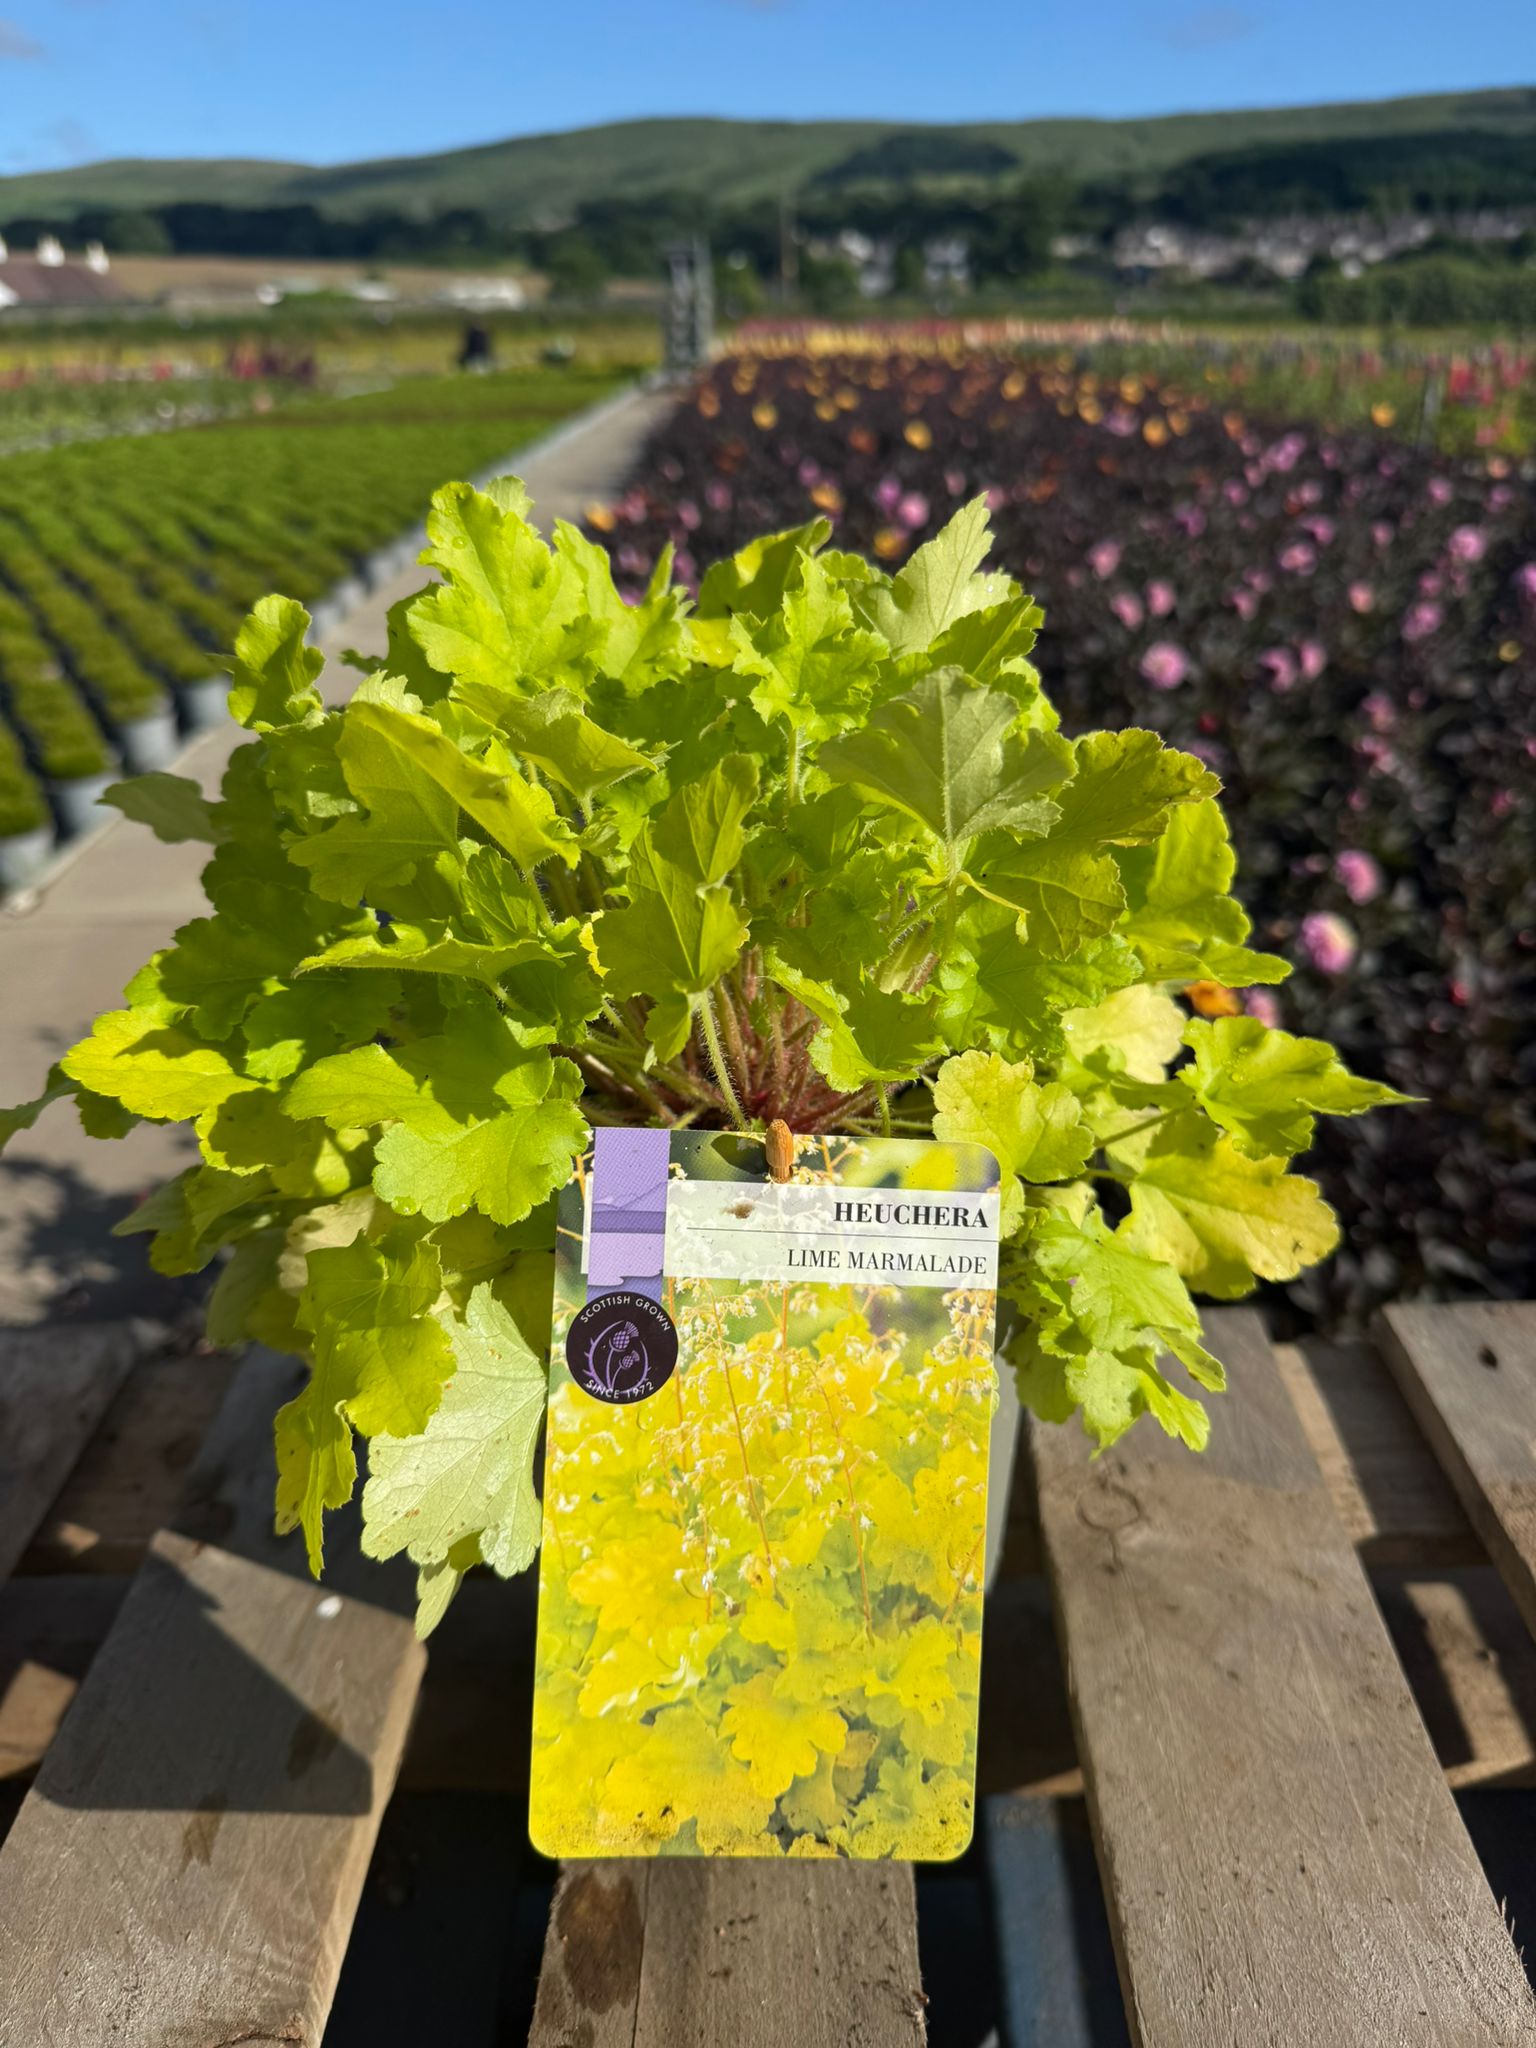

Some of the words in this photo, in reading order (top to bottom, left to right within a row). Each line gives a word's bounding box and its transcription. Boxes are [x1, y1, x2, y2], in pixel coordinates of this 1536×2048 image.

[833, 1201, 990, 1229] HEUCHERA
[787, 1249, 841, 1269] LIME
[847, 1251, 988, 1275] MARMALADE
[580, 1295, 631, 1324] SCOTTISH
[635, 1298, 671, 1332] GROWN
[585, 1379, 620, 1399] SINCE
[625, 1381, 654, 1399] 1972
